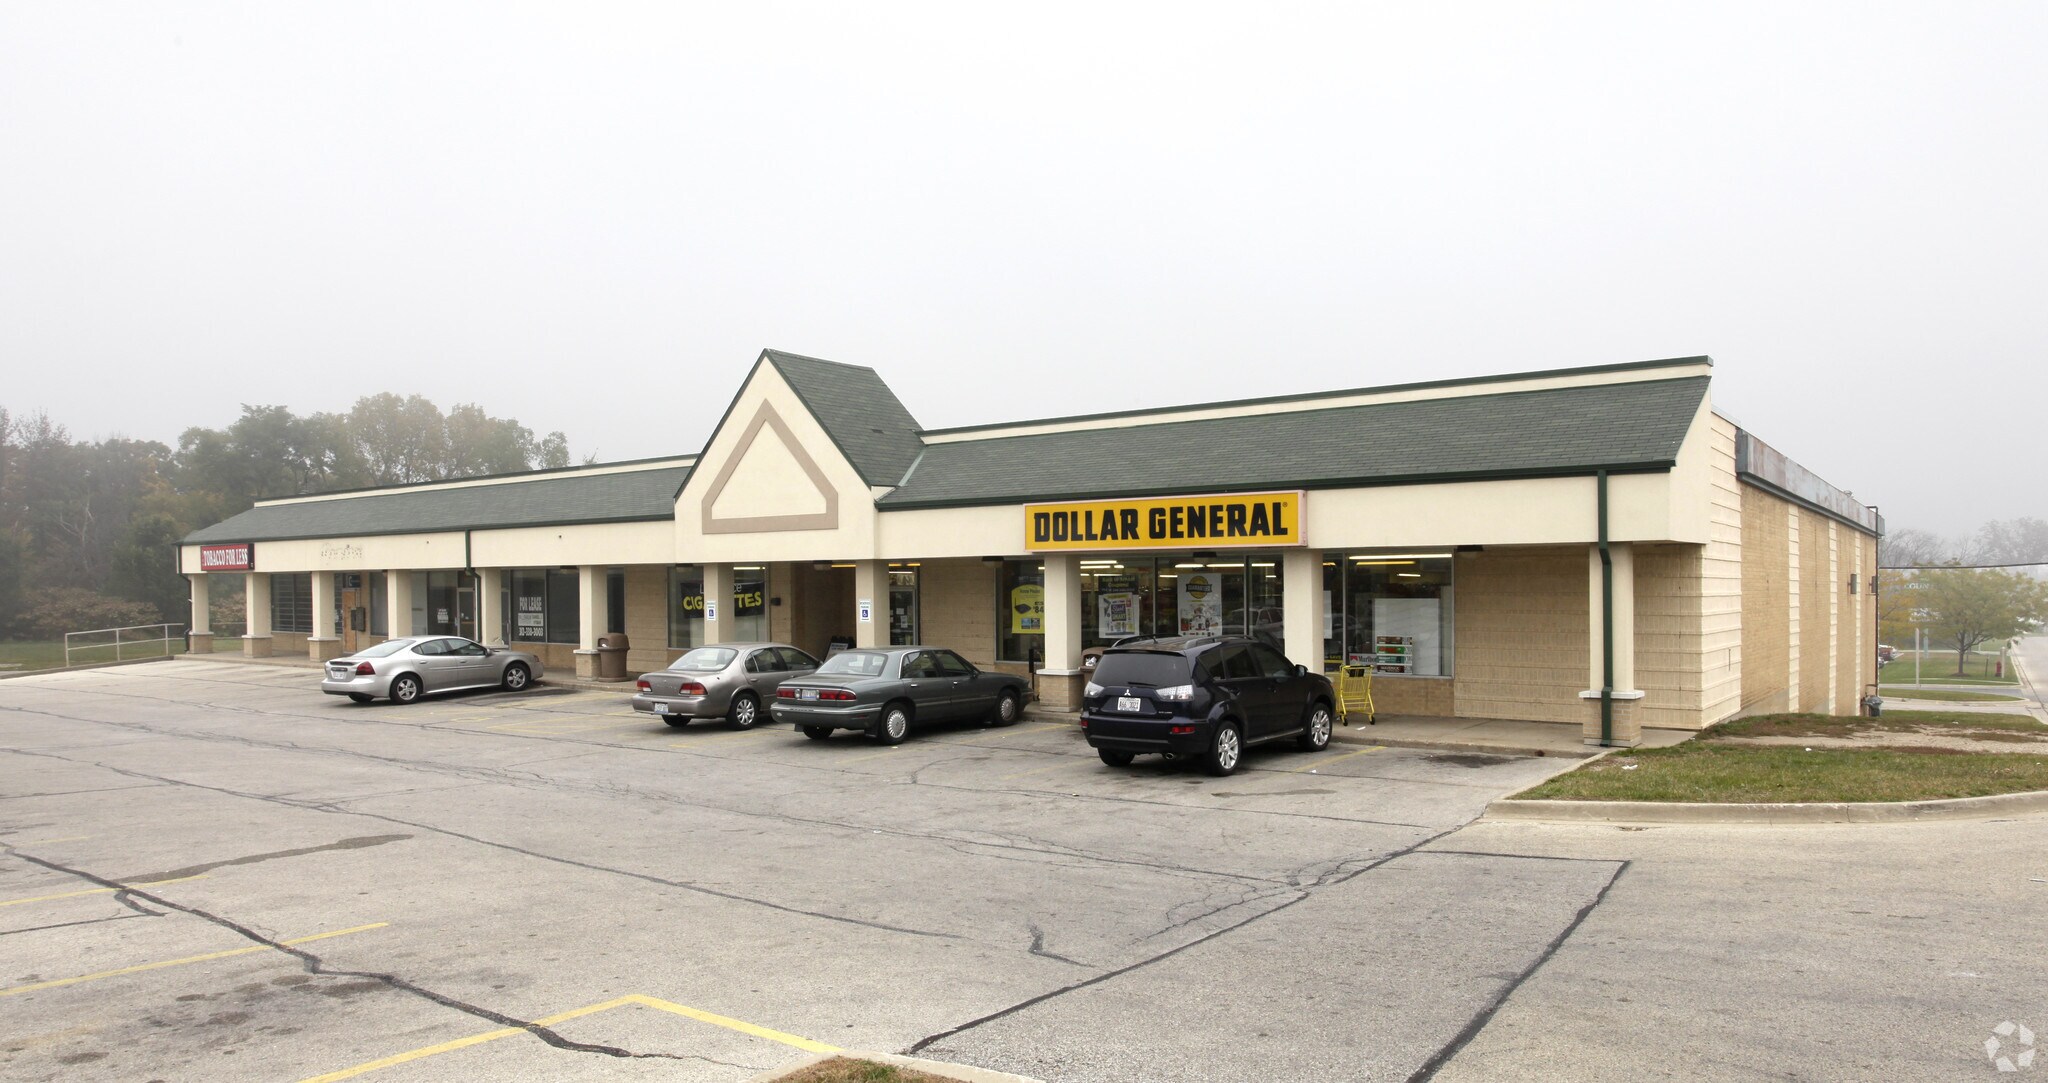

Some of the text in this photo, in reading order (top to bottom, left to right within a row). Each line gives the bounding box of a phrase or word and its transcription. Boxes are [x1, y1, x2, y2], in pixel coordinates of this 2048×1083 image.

[1034, 502, 1288, 542] DOLLAR GENERAL
[203, 548, 248, 566] TOBACCO FOR LESS
[519, 596, 542, 611] FOR LEASE
[683, 591, 762, 610] CIGTES
